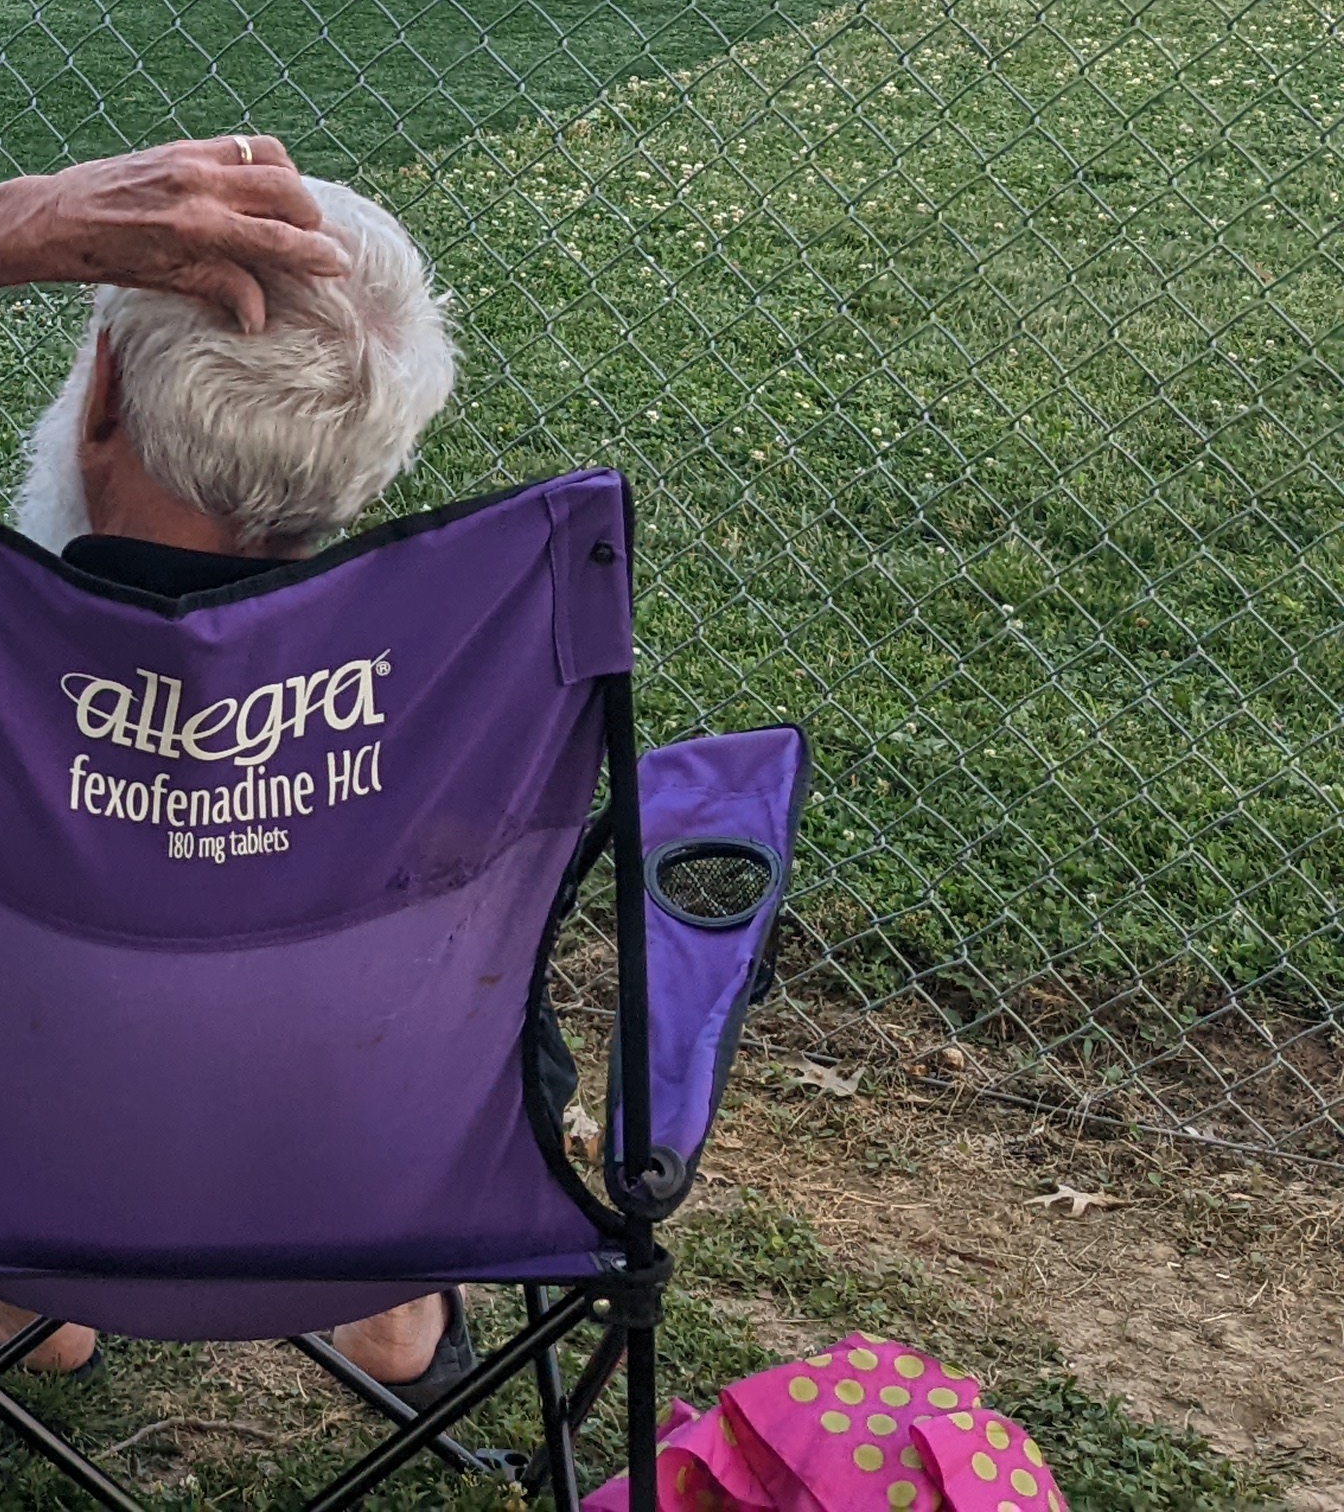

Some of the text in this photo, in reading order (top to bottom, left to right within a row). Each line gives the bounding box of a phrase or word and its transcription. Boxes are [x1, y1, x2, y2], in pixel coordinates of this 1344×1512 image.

[69, 753, 314, 828] fexofenadine
[167, 824, 290, 864] 180 mg tablets
